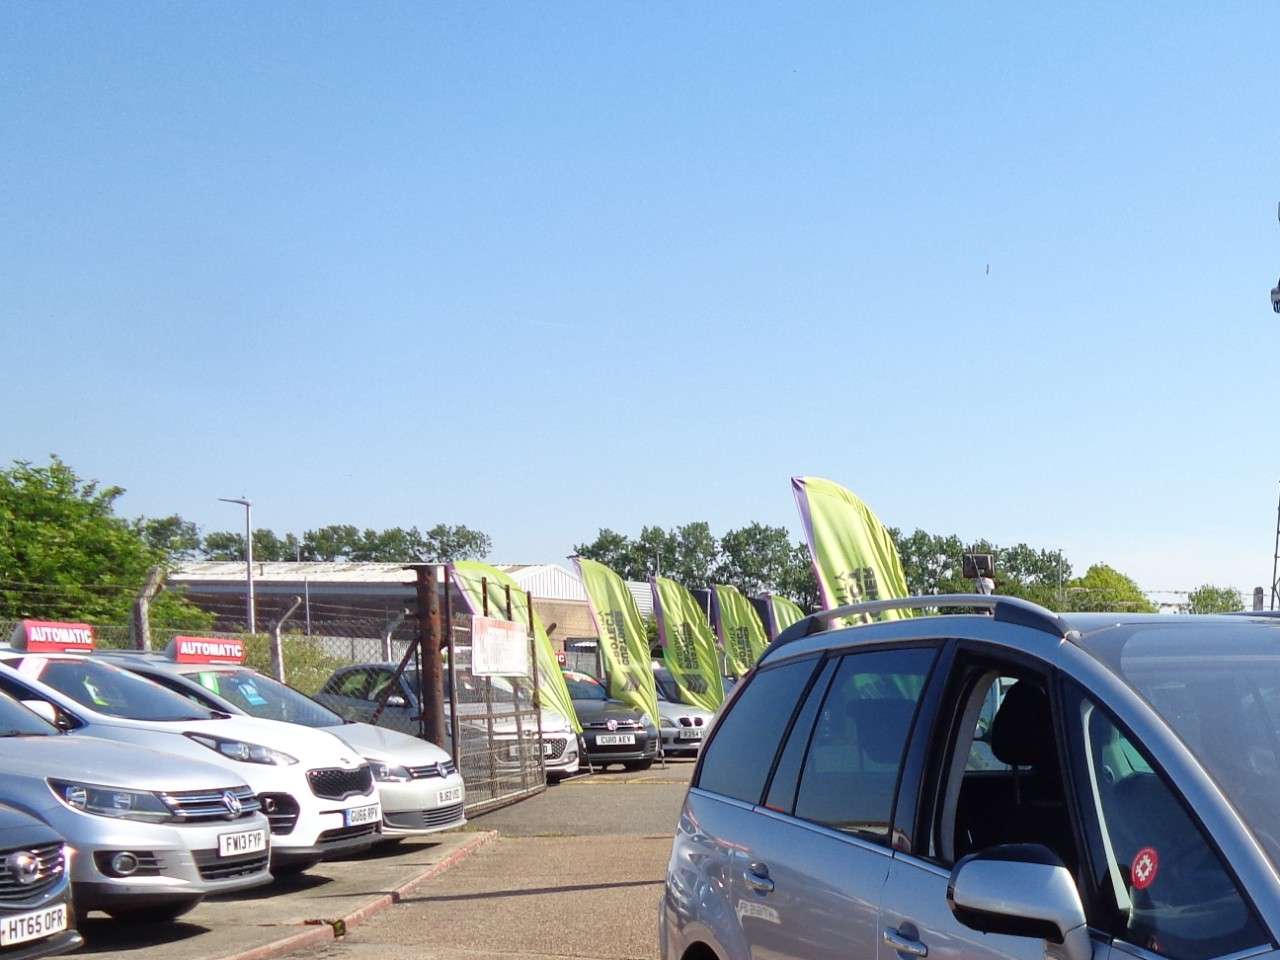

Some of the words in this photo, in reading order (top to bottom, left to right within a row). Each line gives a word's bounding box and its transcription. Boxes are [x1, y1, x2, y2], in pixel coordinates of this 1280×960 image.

[30, 626, 93, 644] AUTOMATIC
[180, 641, 242, 657] AUTOMATIC
[9, 915, 42, 940] HT65
[45, 908, 63, 930] OFR
